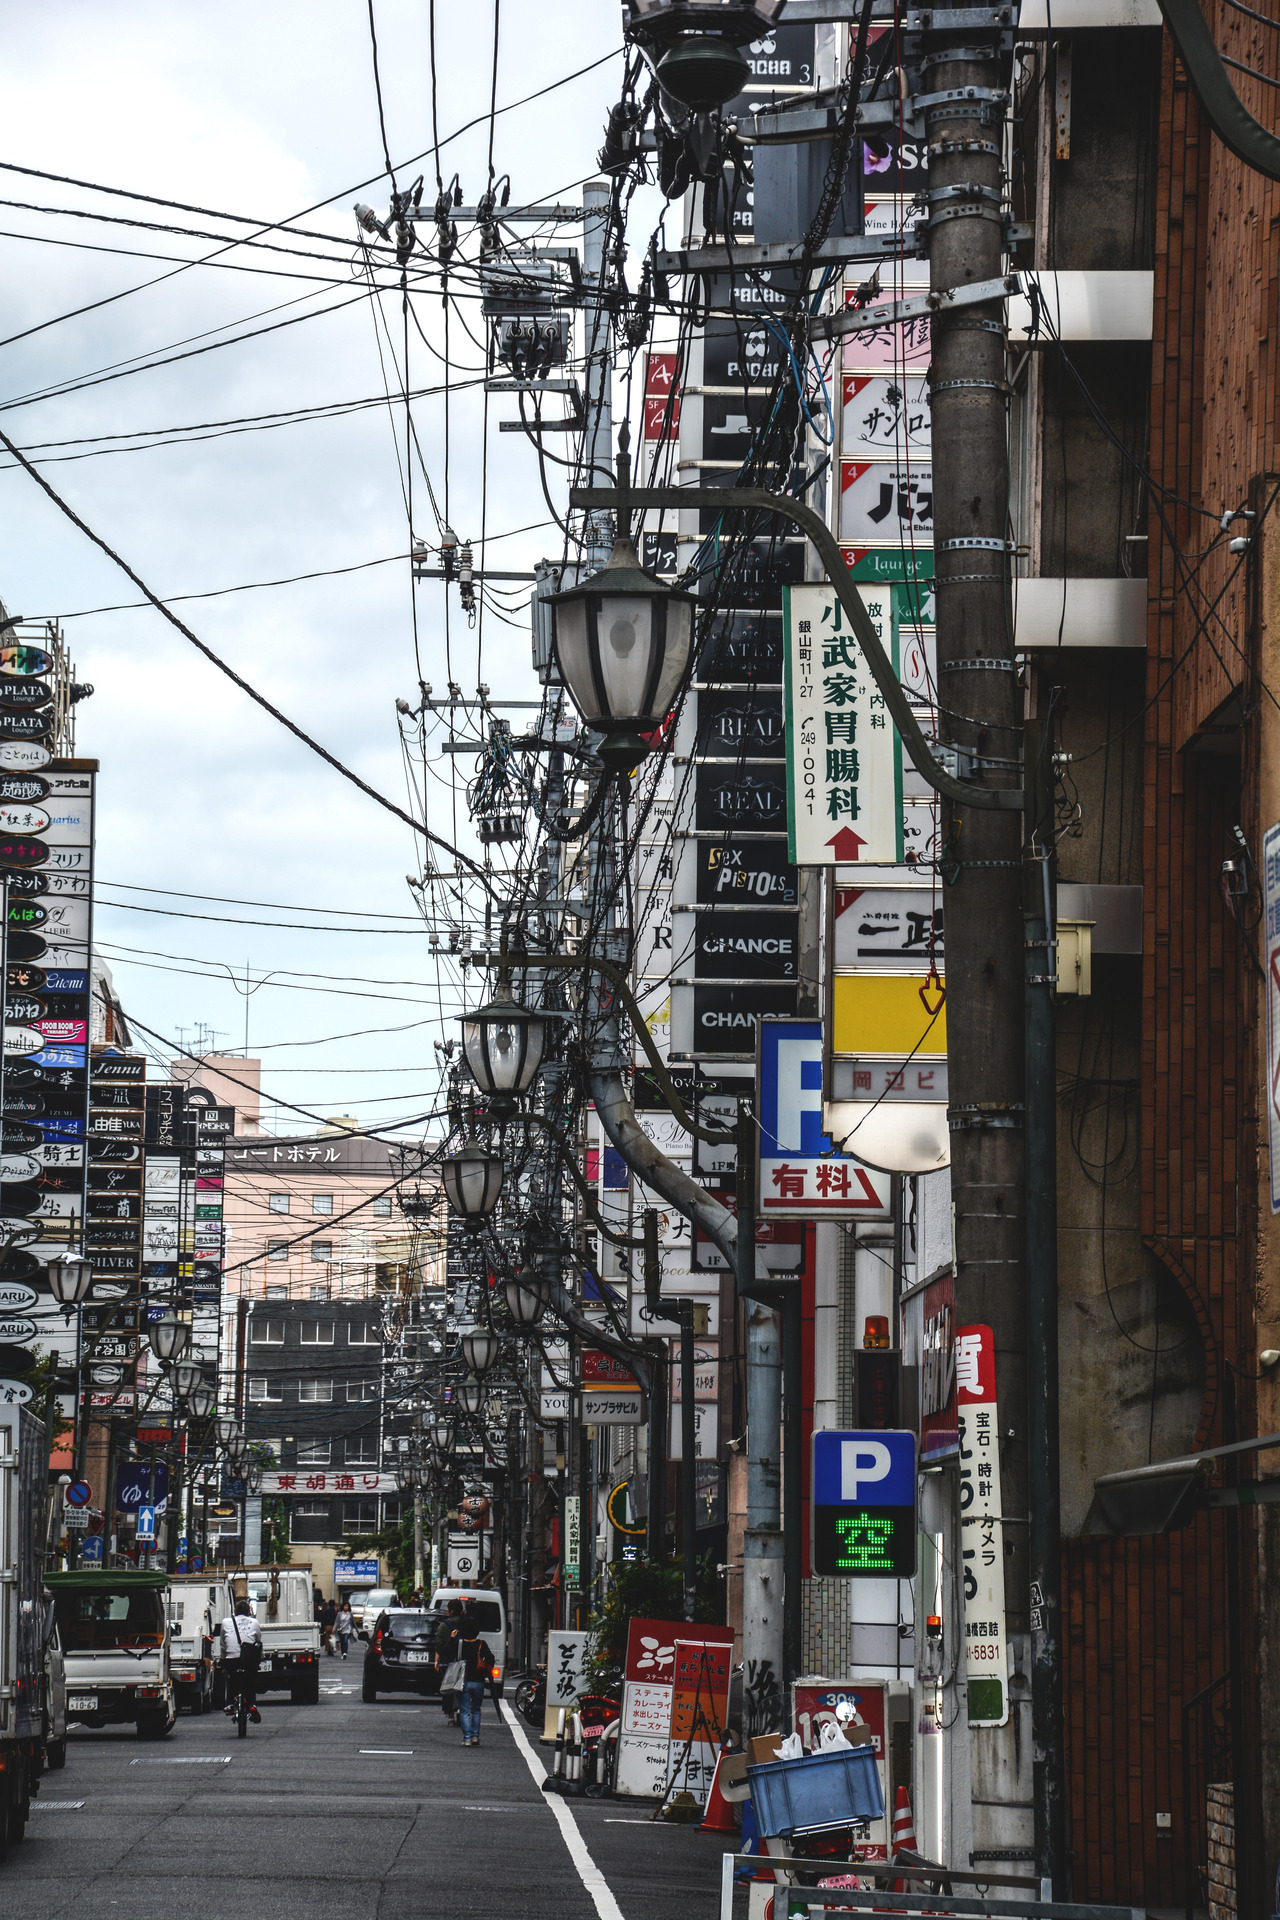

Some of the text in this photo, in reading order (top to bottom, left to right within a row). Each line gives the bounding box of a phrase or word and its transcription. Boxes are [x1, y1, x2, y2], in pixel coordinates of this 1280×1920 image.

[846, 381, 856, 395] 4
[847, 466, 857, 479] 4
[846, 552, 856, 566] 3
[4, 685, 45, 696] PLATA
[13, 695, 36, 703] Lounge
[820, 594, 862, 822] 小武家胃腸科
[3, 716, 44, 728] PLATA
[719, 717, 781, 736] REAL
[11, 726, 35, 734] Lounge
[719, 790, 781, 810] REAL
[783, 889, 795, 902] 2
[702, 938, 792, 954] CHANCE
[784, 962, 793, 975] 2
[94, 1117, 123, 1132] 由佳
[772, 1163, 852, 1198] 有料
[585, 1401, 638, 1414] サンプラザビル
[841, 1441, 891, 1500] P
[836, 1513, 894, 1568] 空
[634, 1688, 671, 1699] ステーキ
[623, 1740, 670, 1751] チーズケーキの
